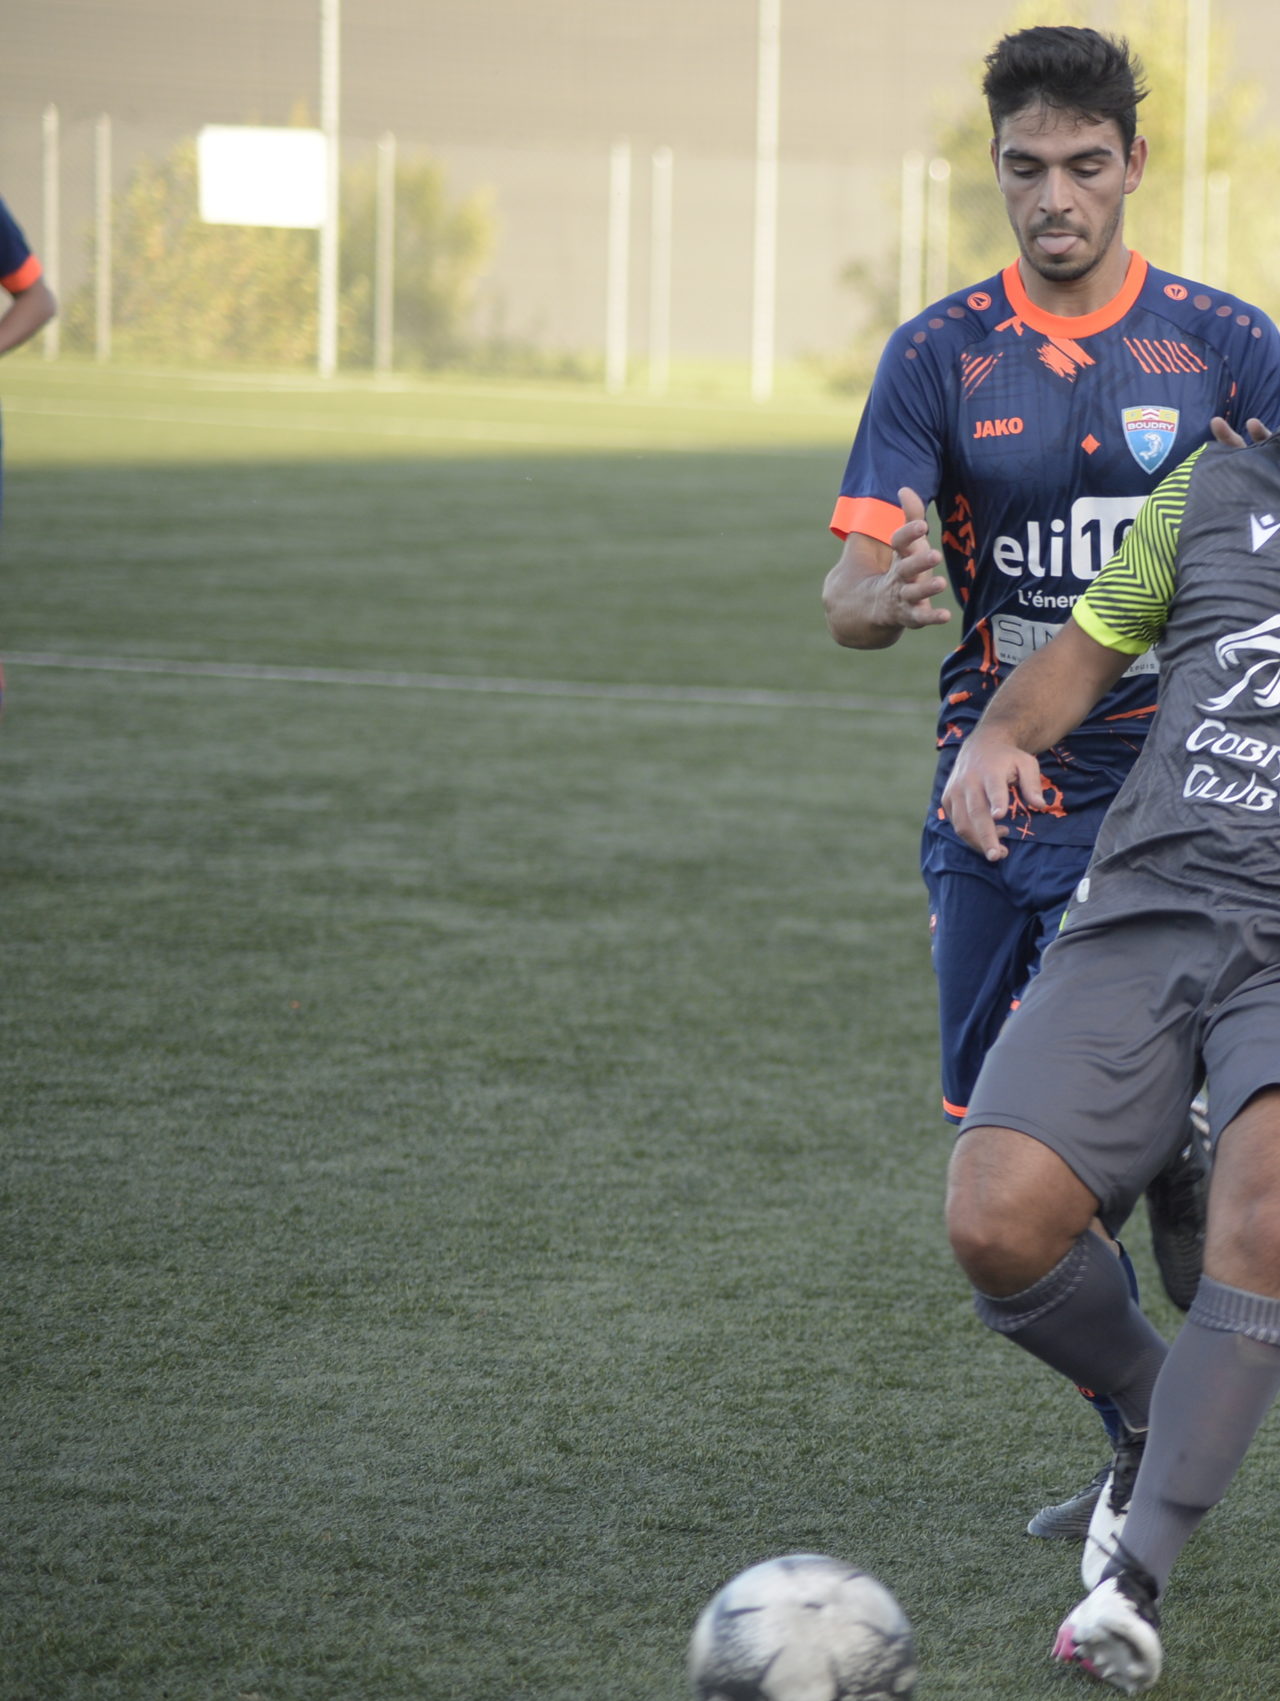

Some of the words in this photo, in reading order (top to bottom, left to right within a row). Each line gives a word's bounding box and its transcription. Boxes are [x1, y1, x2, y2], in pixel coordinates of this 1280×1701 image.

[973, 416, 1024, 438] JAKO
[1127, 421, 1175, 431] BOUDRY
[1017, 588, 1085, 608] L'éner
[1129, 663, 1156, 672] EPUIS
[1183, 763, 1278, 812] CLUB
